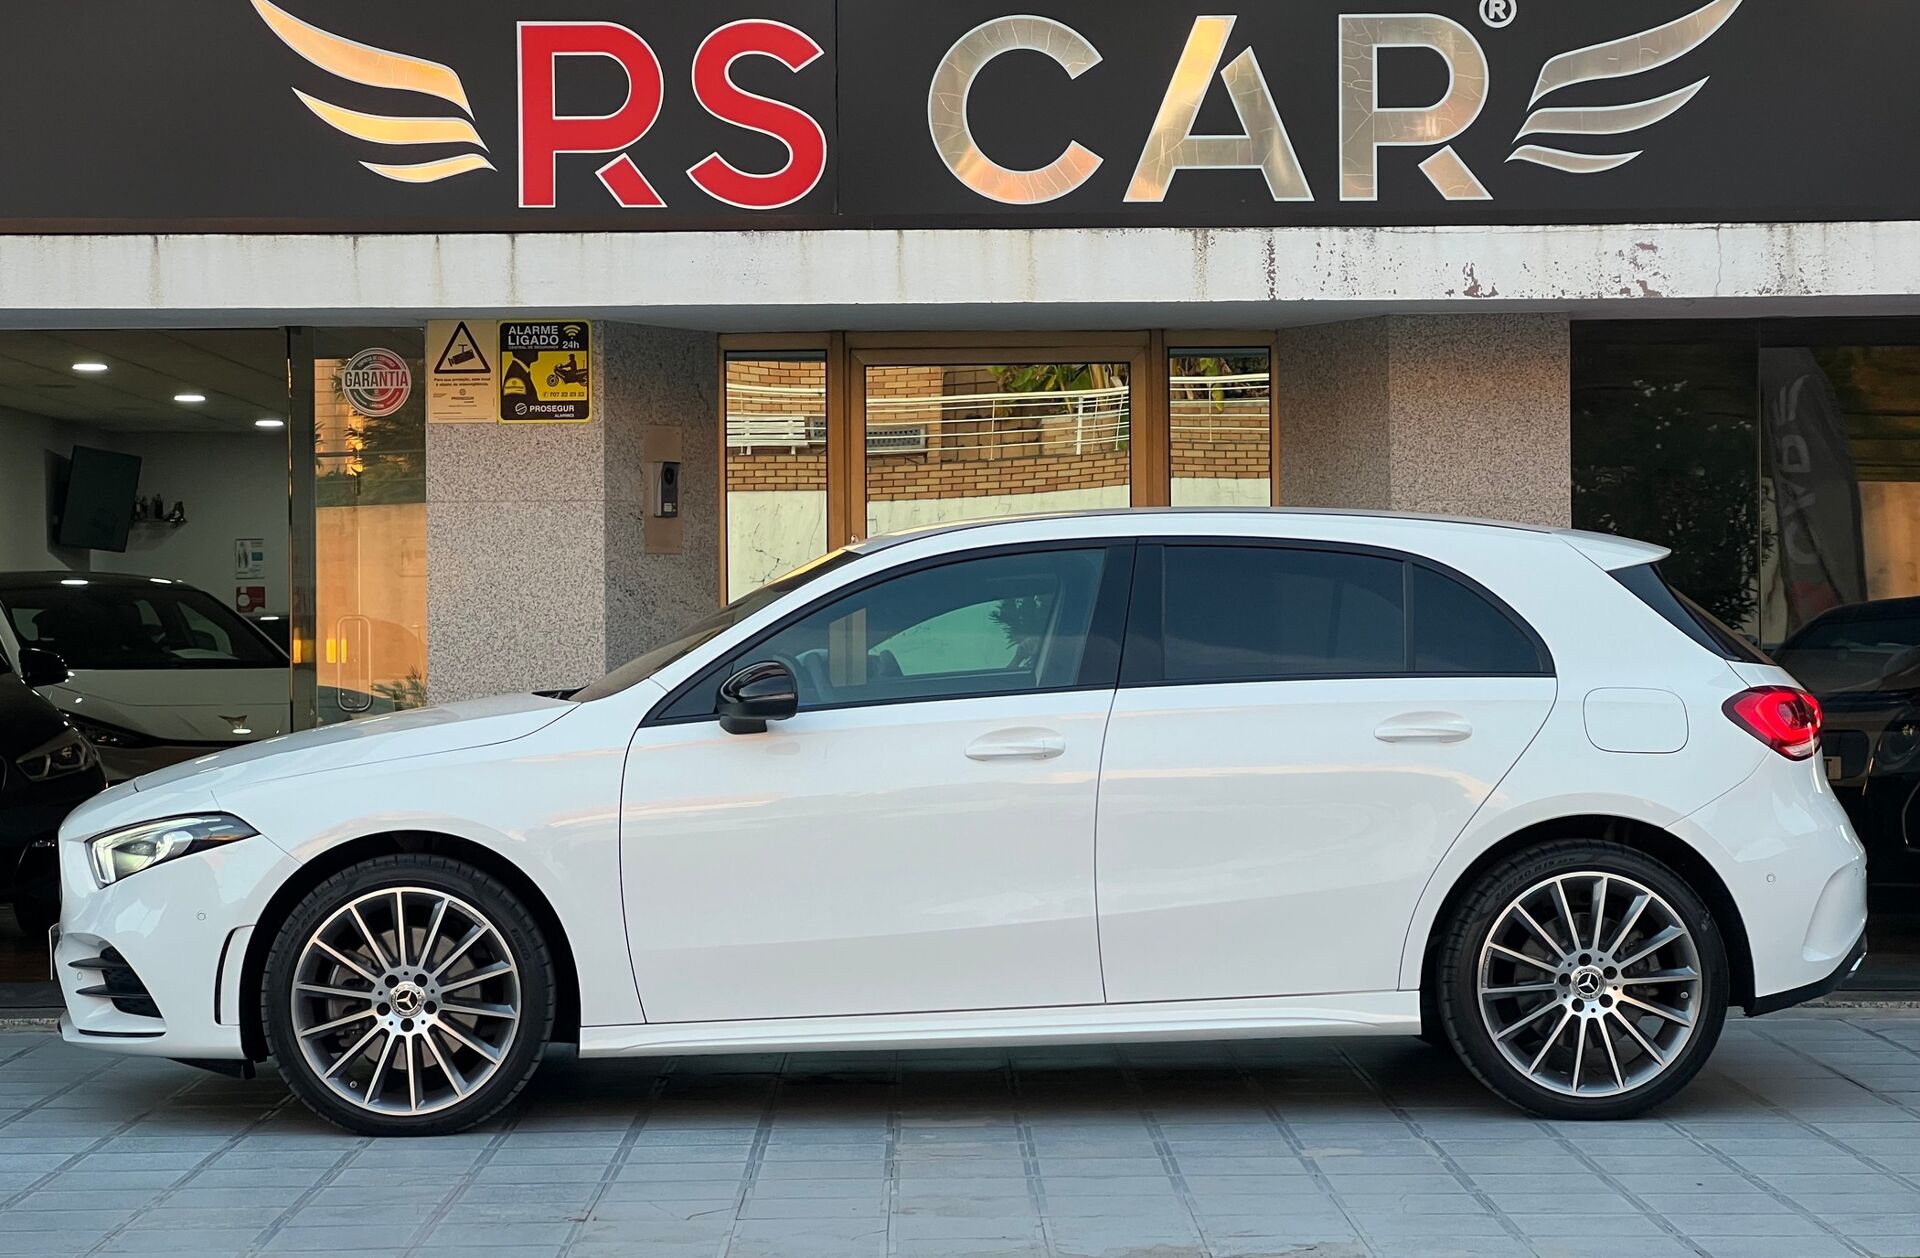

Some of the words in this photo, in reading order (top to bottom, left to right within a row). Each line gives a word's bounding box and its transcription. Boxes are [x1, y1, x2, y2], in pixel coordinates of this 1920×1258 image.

[516, 18, 827, 210] RS
[927, 13, 1494, 206] CAR
[508, 325, 559, 335] ALARME
[508, 335, 559, 346] LIGADO
[562, 340, 580, 349] 24h
[345, 371, 409, 387] GARANTIA
[529, 405, 575, 413] PROSEGUR
